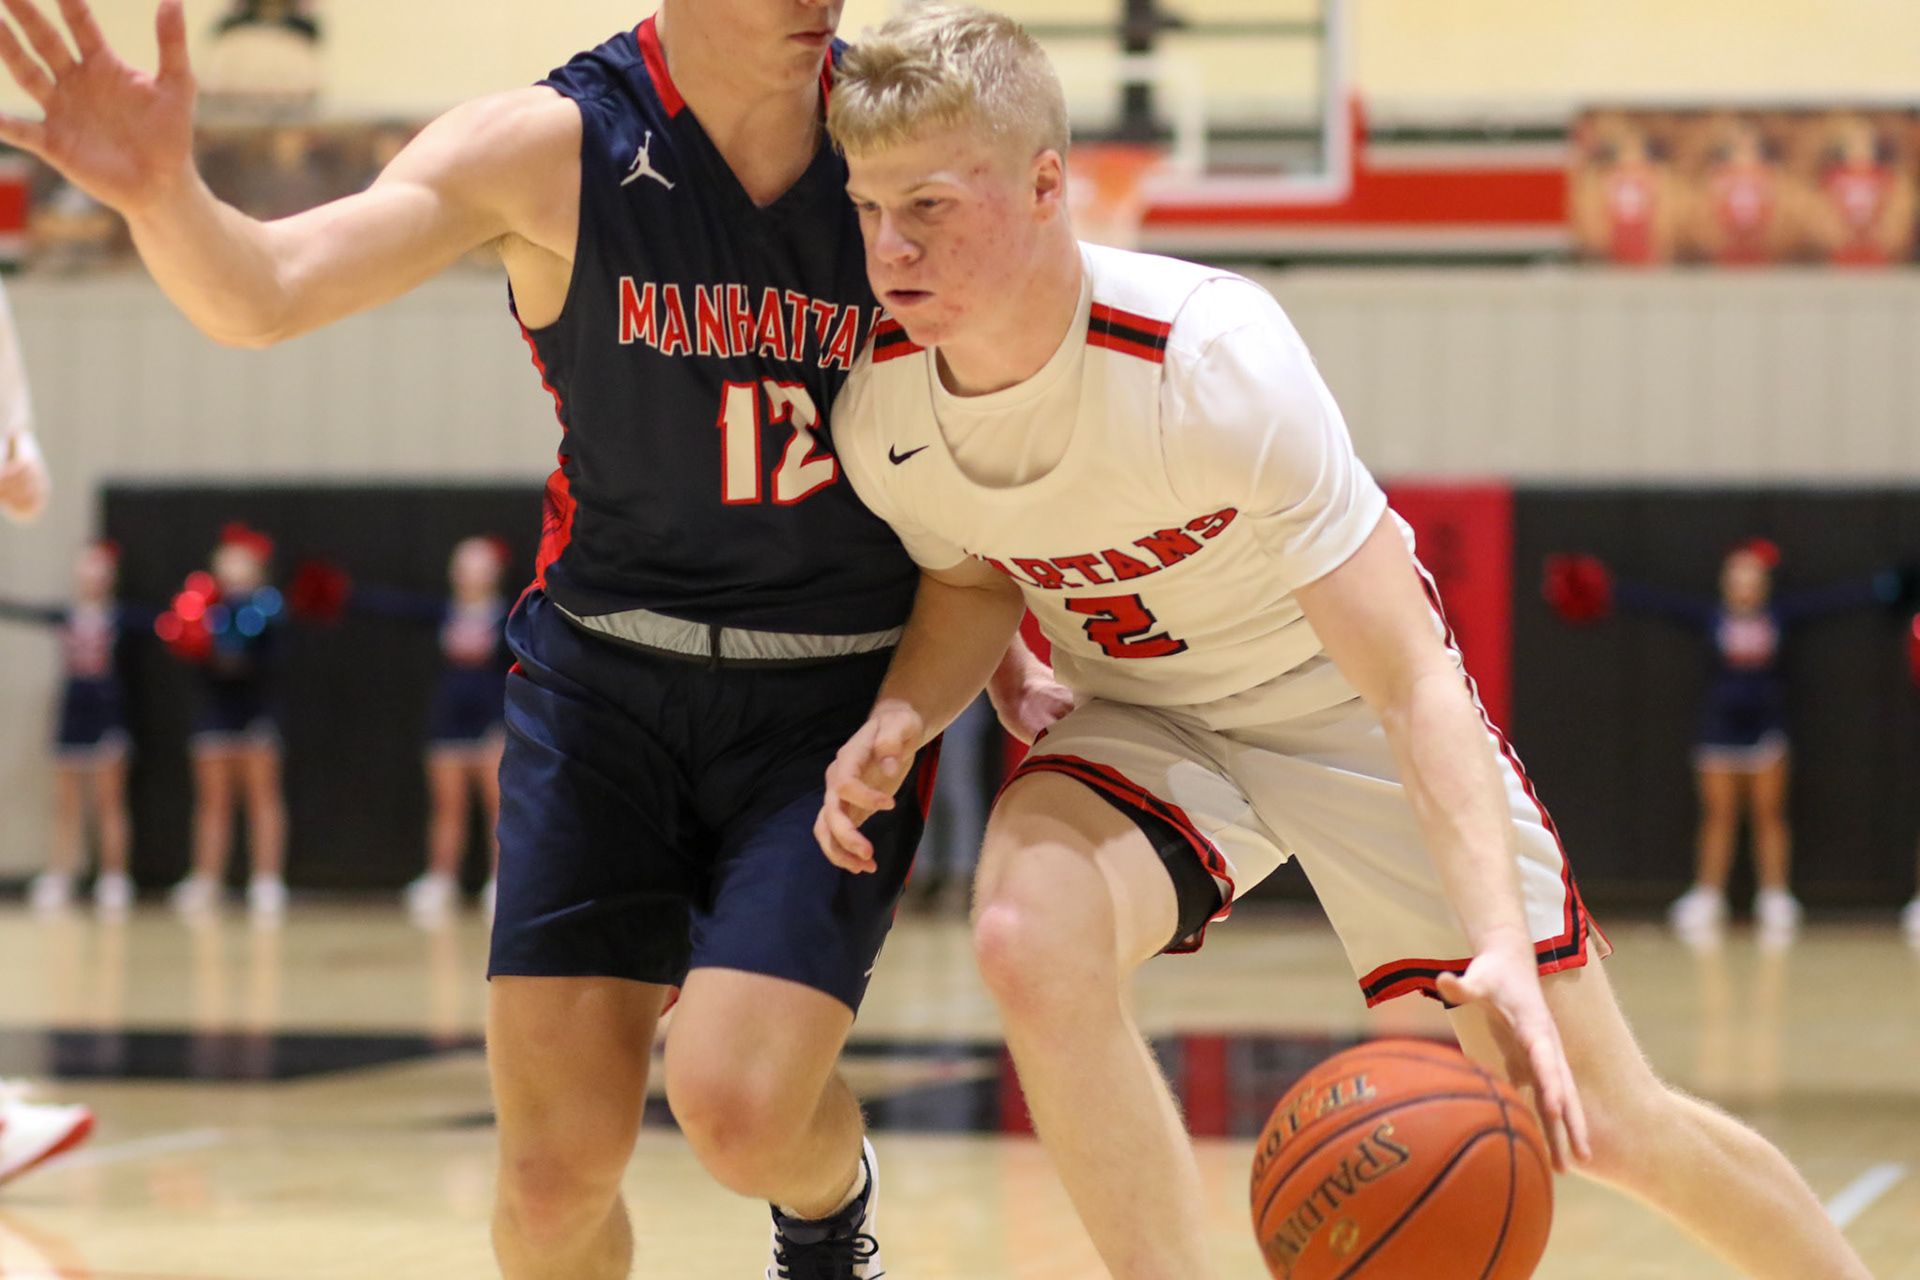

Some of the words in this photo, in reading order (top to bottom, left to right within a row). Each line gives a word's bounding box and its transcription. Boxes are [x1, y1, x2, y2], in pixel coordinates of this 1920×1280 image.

[716, 376, 839, 505] 12
[963, 507, 1238, 589] RTANS
[1065, 594, 1189, 659] 2
